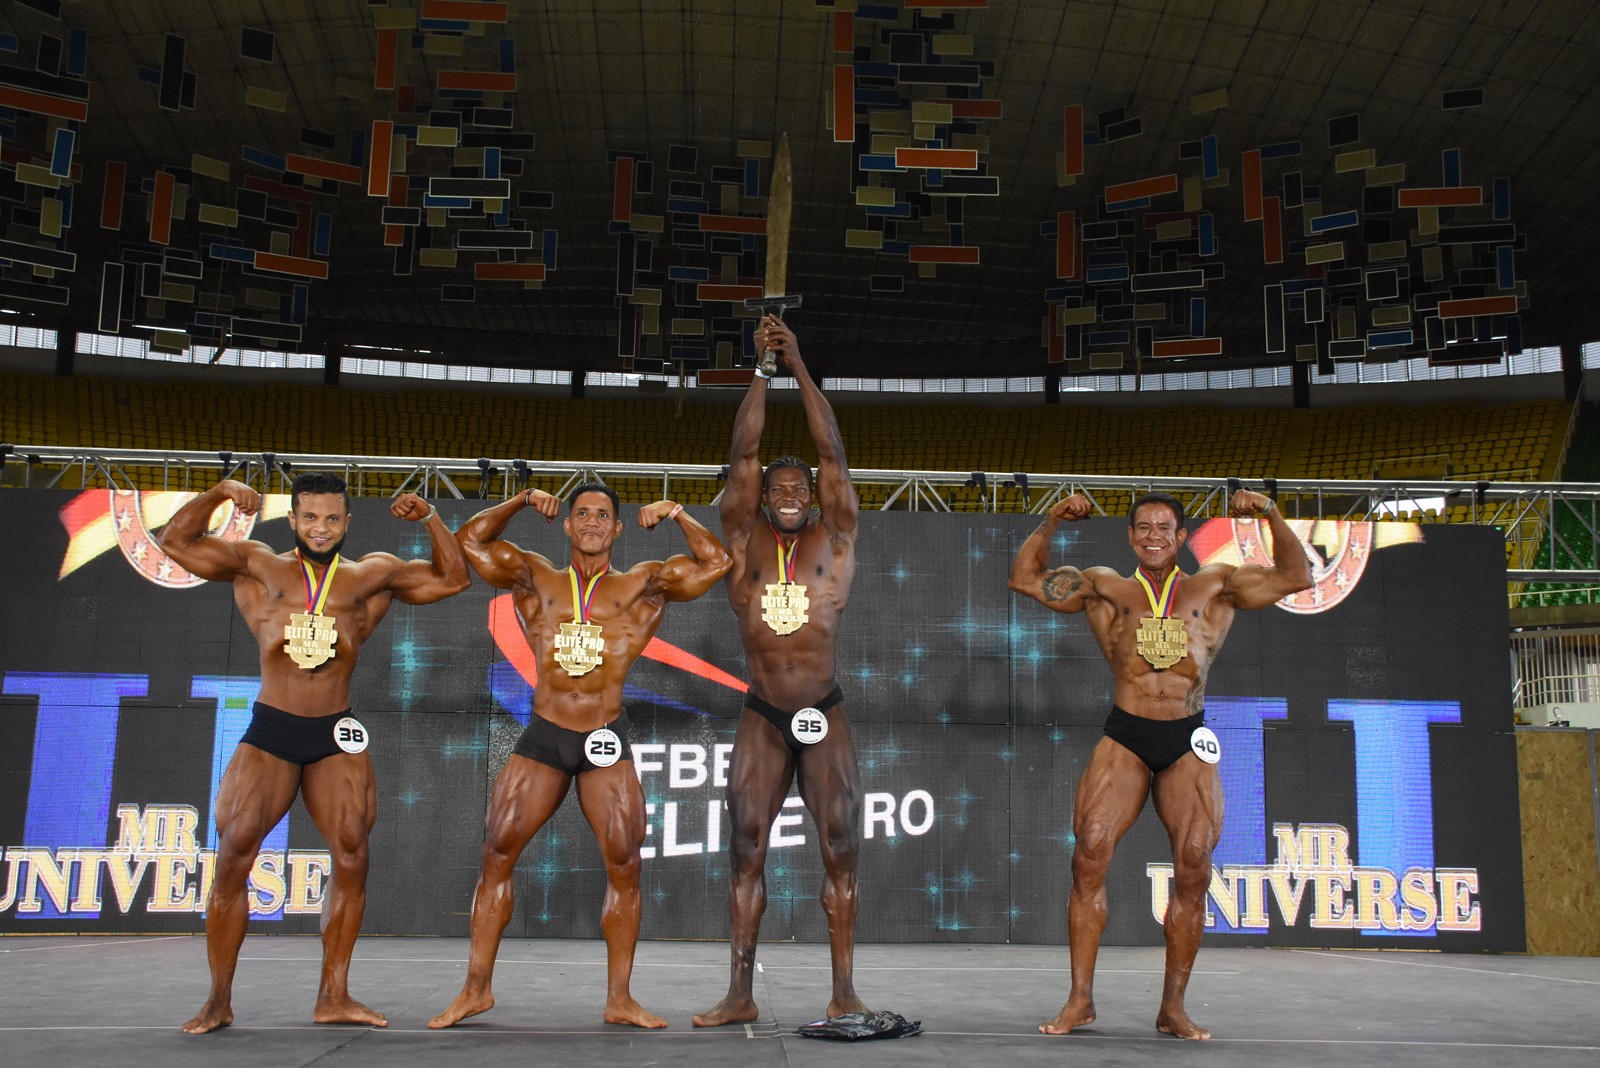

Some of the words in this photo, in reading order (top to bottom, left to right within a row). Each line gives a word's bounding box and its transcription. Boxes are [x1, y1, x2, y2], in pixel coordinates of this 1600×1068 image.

[761, 596, 788, 608] ELITE
[788, 597, 810, 610] PRO
[761, 614, 809, 623] UNIVERSE
[284, 625, 314, 640] ELITE
[314, 628, 338, 644] PRO
[1136, 629, 1165, 642] ELITE
[1165, 631, 1188, 645] PRO
[303, 640, 319, 648] MR
[554, 634, 582, 648] ELITE
[582, 638, 605, 652] PRO
[1154, 641, 1171, 649] MR
[284, 645, 336, 658] UNIVERSE
[554, 653, 603, 665] UNIVERSE
[571, 648, 587, 656] MR
[1137, 647, 1187, 657] UNIVERSE
[797, 720, 822, 733] 35
[339, 727, 365, 742] 38
[590, 740, 617, 756] 25
[1194, 738, 1218, 754] 40
[629, 744, 734, 788] FB
[114, 803, 200, 854] MR
[640, 797, 806, 859] LIE
[863, 790, 935, 839] RO
[1272, 822, 1355, 872] MR
